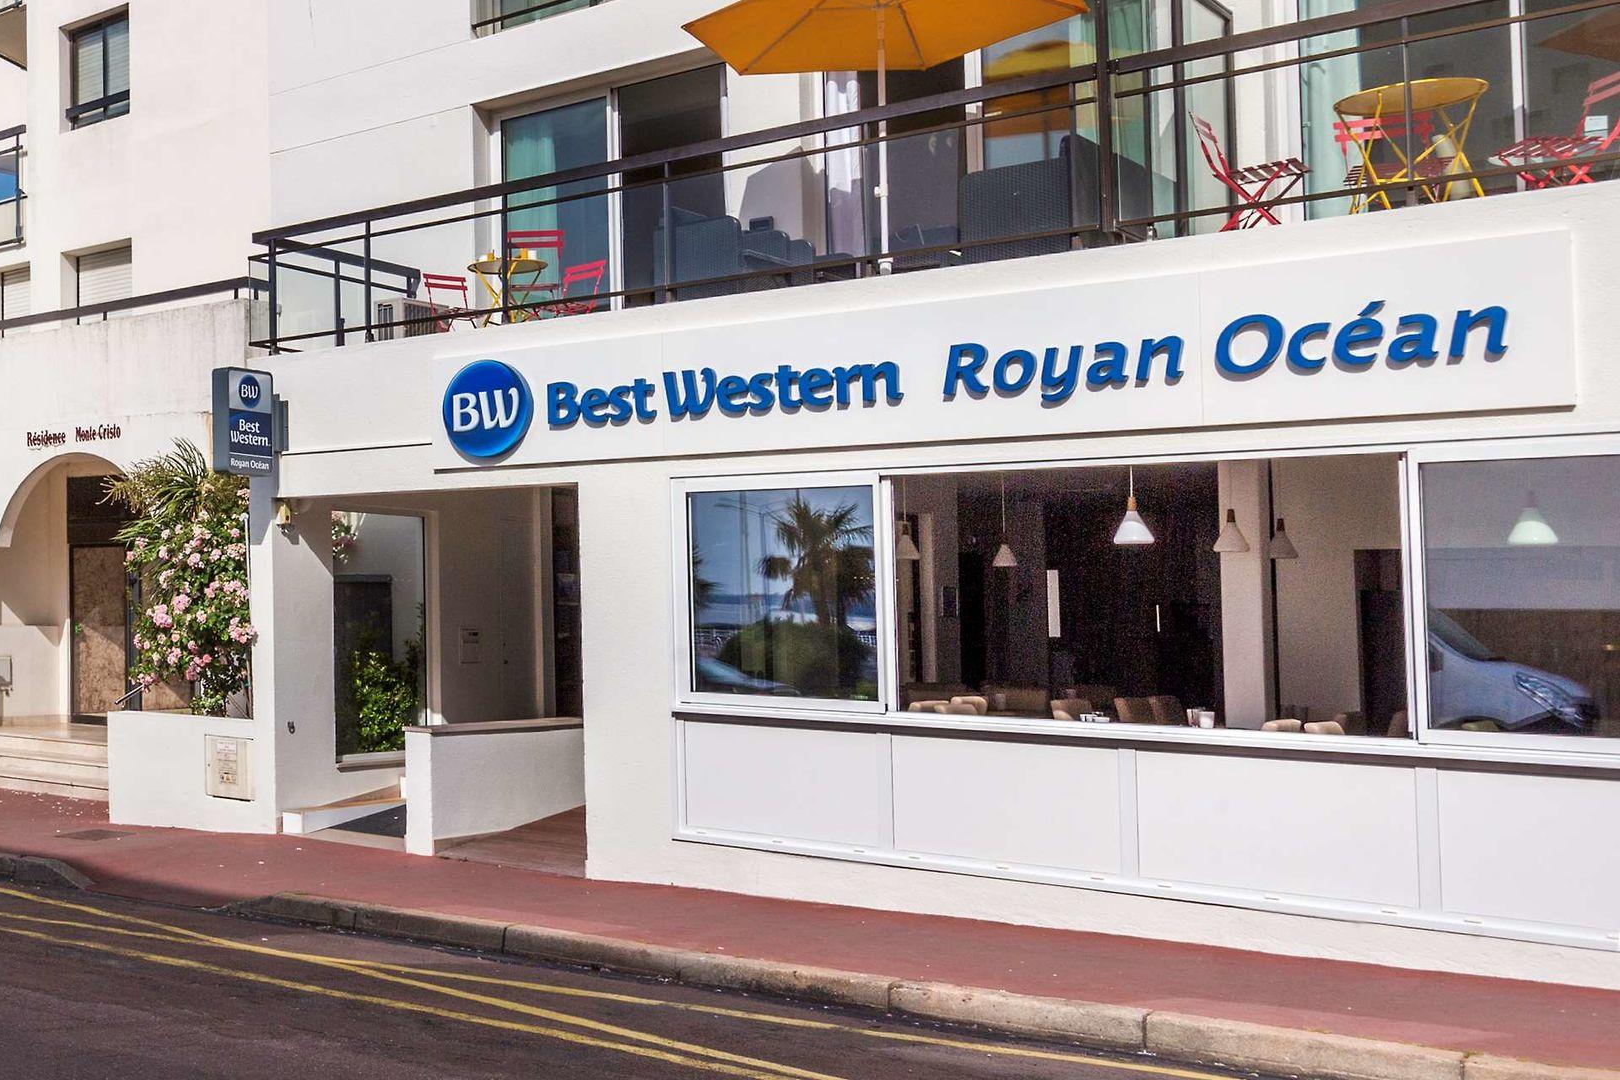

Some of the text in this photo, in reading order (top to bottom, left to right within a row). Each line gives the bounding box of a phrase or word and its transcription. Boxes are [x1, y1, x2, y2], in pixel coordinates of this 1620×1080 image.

[452, 300, 1509, 432] BW Best Western Royan Océan
[240, 384, 259, 399] BW
[239, 419, 260, 433] Best
[26, 430, 67, 447] Résidence
[230, 458, 270, 470] Royan Océan
